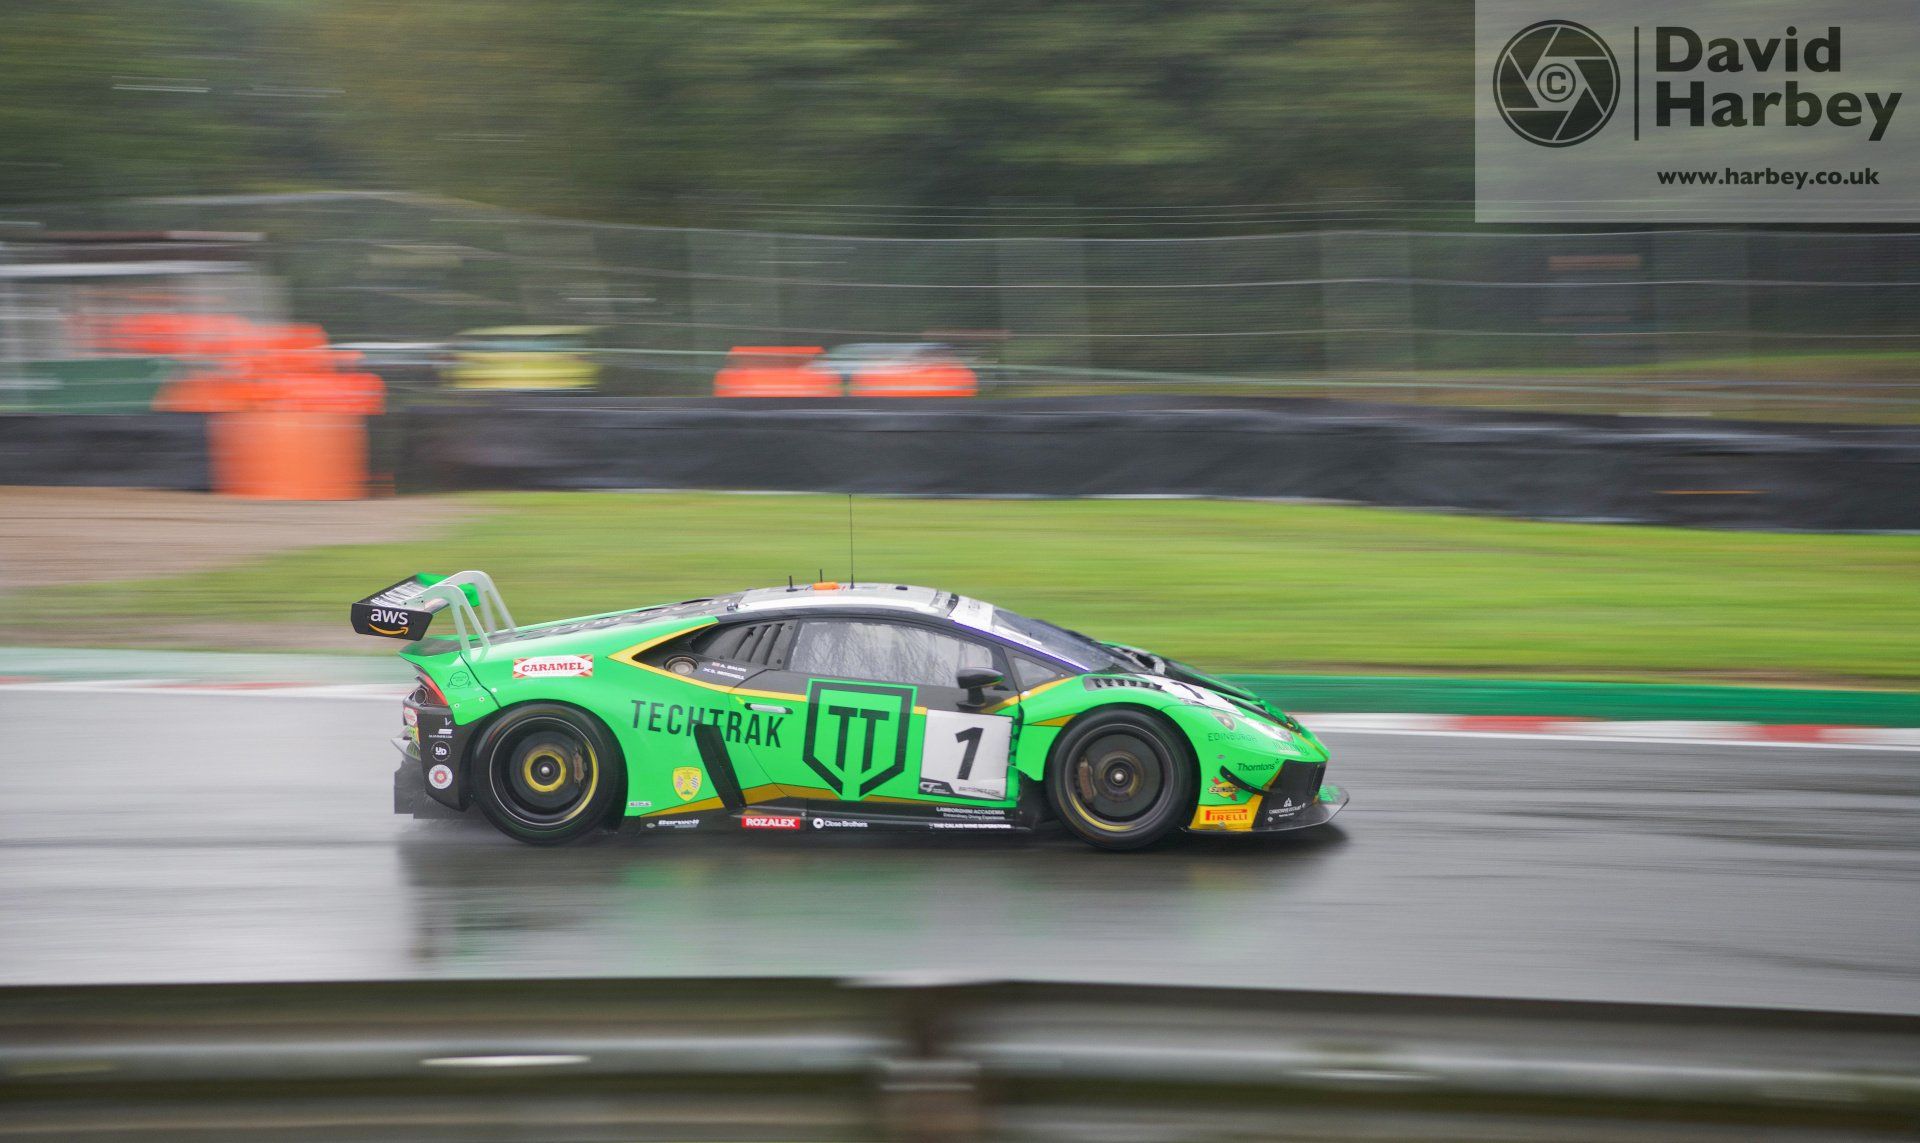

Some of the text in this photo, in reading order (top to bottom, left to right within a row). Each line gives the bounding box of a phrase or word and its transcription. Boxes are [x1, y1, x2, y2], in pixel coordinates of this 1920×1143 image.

[370, 608, 409, 625] aws
[521, 662, 585, 672] CARAMEL
[631, 700, 784, 748] TECHTRAK
[955, 727, 984, 780] 1
[1205, 808, 1248, 821] PIRELLI
[745, 818, 796, 827] ROZALEX
